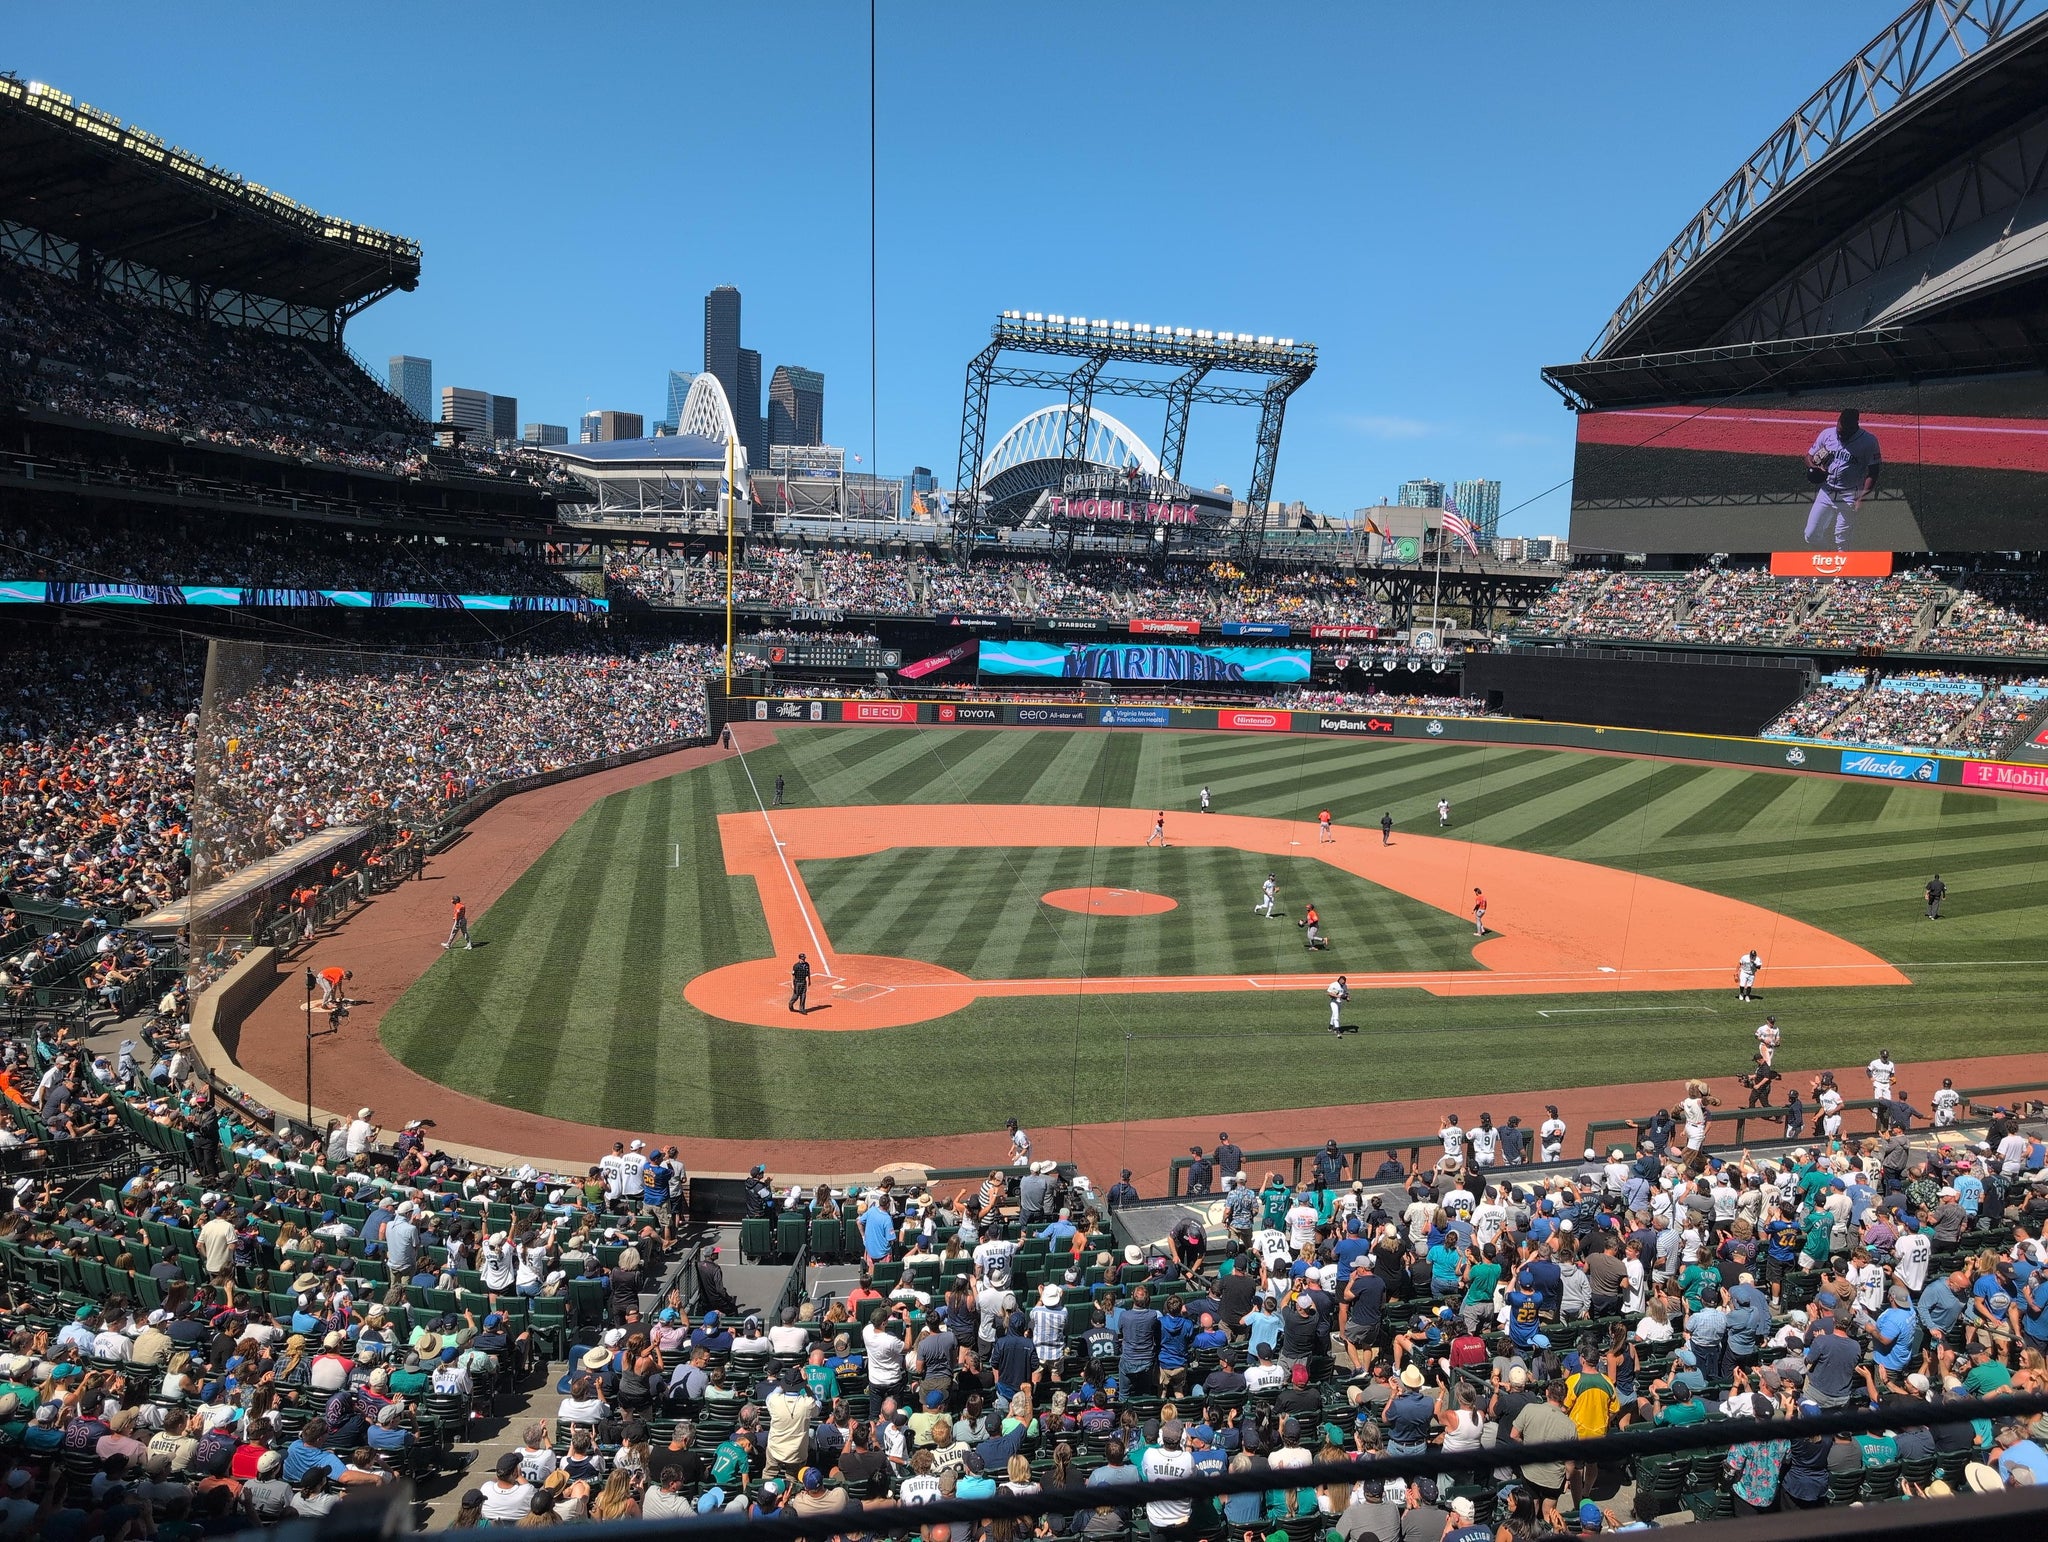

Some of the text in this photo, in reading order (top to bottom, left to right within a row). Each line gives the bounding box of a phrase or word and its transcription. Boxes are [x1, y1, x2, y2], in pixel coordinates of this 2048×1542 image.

[1049, 497, 1199, 525] T-MOBILE PARK
[1812, 556, 1847, 566] fire tv
[1058, 621, 1096, 629] STARBUCKS
[1062, 647, 1245, 682] MARINERS
[1932, 682, 1967, 690] SQUAD
[861, 708, 899, 717] BECU
[958, 706, 995, 718] TOYOTA
[1019, 709, 1047, 720] eero
[1050, 711, 1071, 719] All-star
[1116, 710, 1140, 718] Virginia
[1152, 717, 1166, 725] Health
[1237, 716, 1272, 725] Nintendo
[1321, 718, 1367, 731] KeyBank
[1790, 751, 1802, 759] 50
[1845, 755, 1906, 776] Alaska
[1978, 766, 1993, 781] T
[1451, 1135, 1462, 1146] 30
[1484, 1136, 1491, 1146] 9
[624, 1164, 638, 1176] 29
[1869, 1169, 1880, 1180] 22
[1769, 1194, 1780, 1207] 44
[1966, 1189, 1979, 1200] 29
[1270, 1203, 1285, 1214] 24
[1454, 1199, 1468, 1211] 26
[1486, 1219, 1500, 1231] 75
[1267, 1239, 1286, 1253] 24
[1778, 1235, 1796, 1247] 44
[1913, 1248, 1928, 1263] 22
[490, 1260, 500, 1271] 3
[988, 1256, 1005, 1270] 29
[1517, 1309, 1537, 1323] 22
[1089, 1332, 1114, 1344] RALEIGH
[1092, 1341, 1115, 1357] 29
[65, 1424, 90, 1448] 26
[150, 1440, 181, 1453] GRIFFEY
[719, 1456, 731, 1472] 17
[1153, 1463, 1186, 1478] SUÁREZ
[909, 1481, 939, 1492] GRIFFEY
